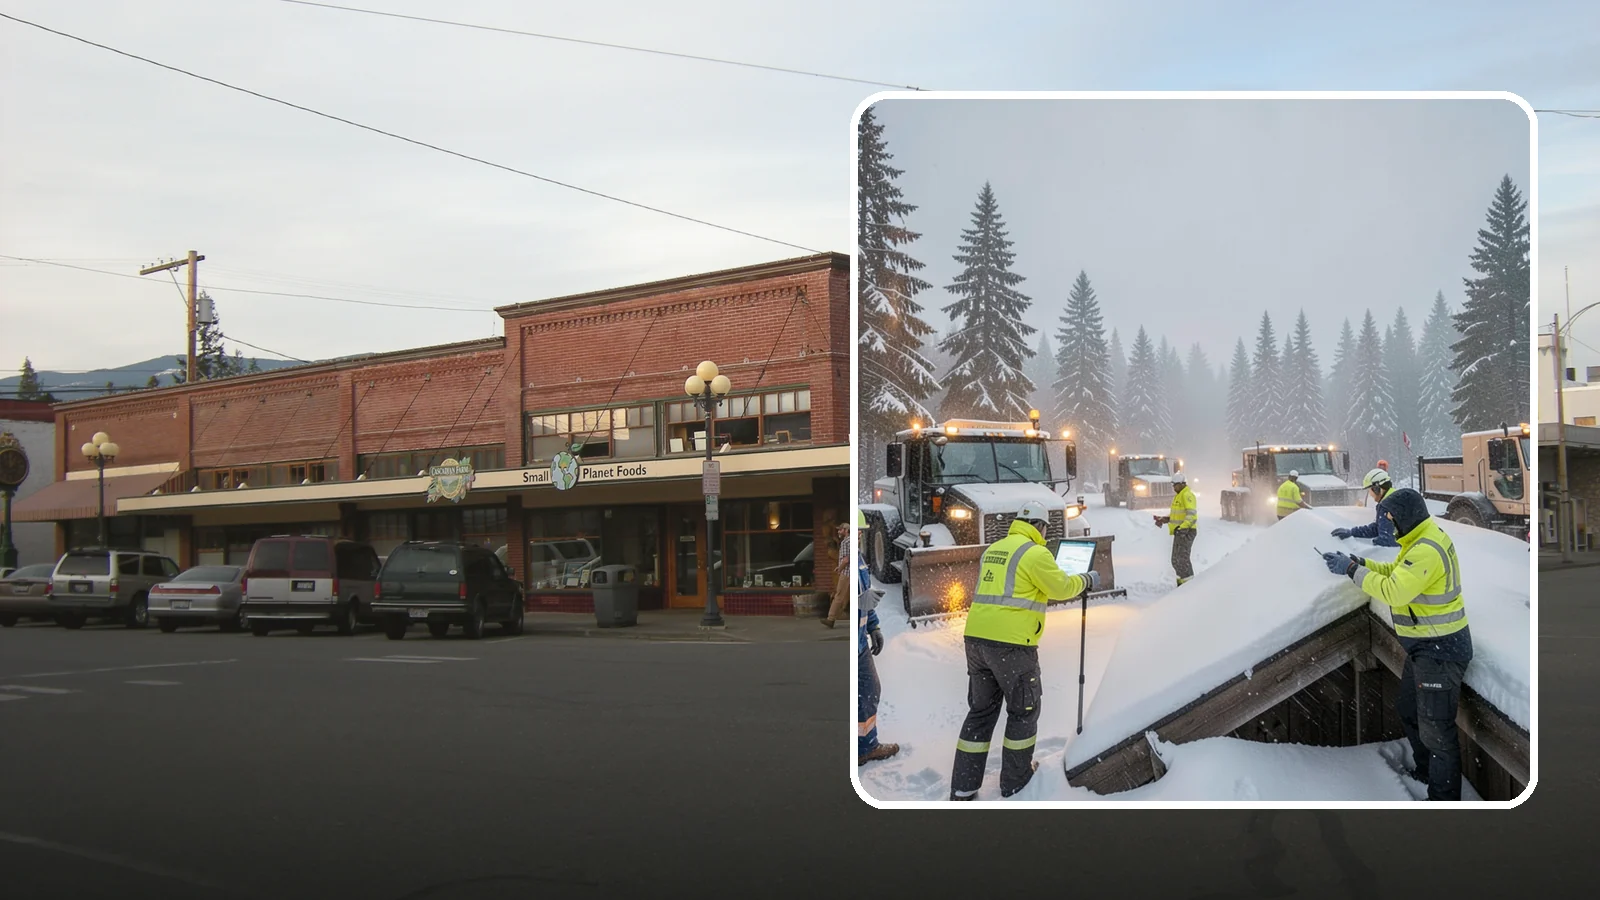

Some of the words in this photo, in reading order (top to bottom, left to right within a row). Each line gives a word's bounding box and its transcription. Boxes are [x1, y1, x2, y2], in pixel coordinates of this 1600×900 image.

[523, 470, 549, 483] Small
[583, 467, 614, 479] Planet
[617, 464, 647, 477] Foods
